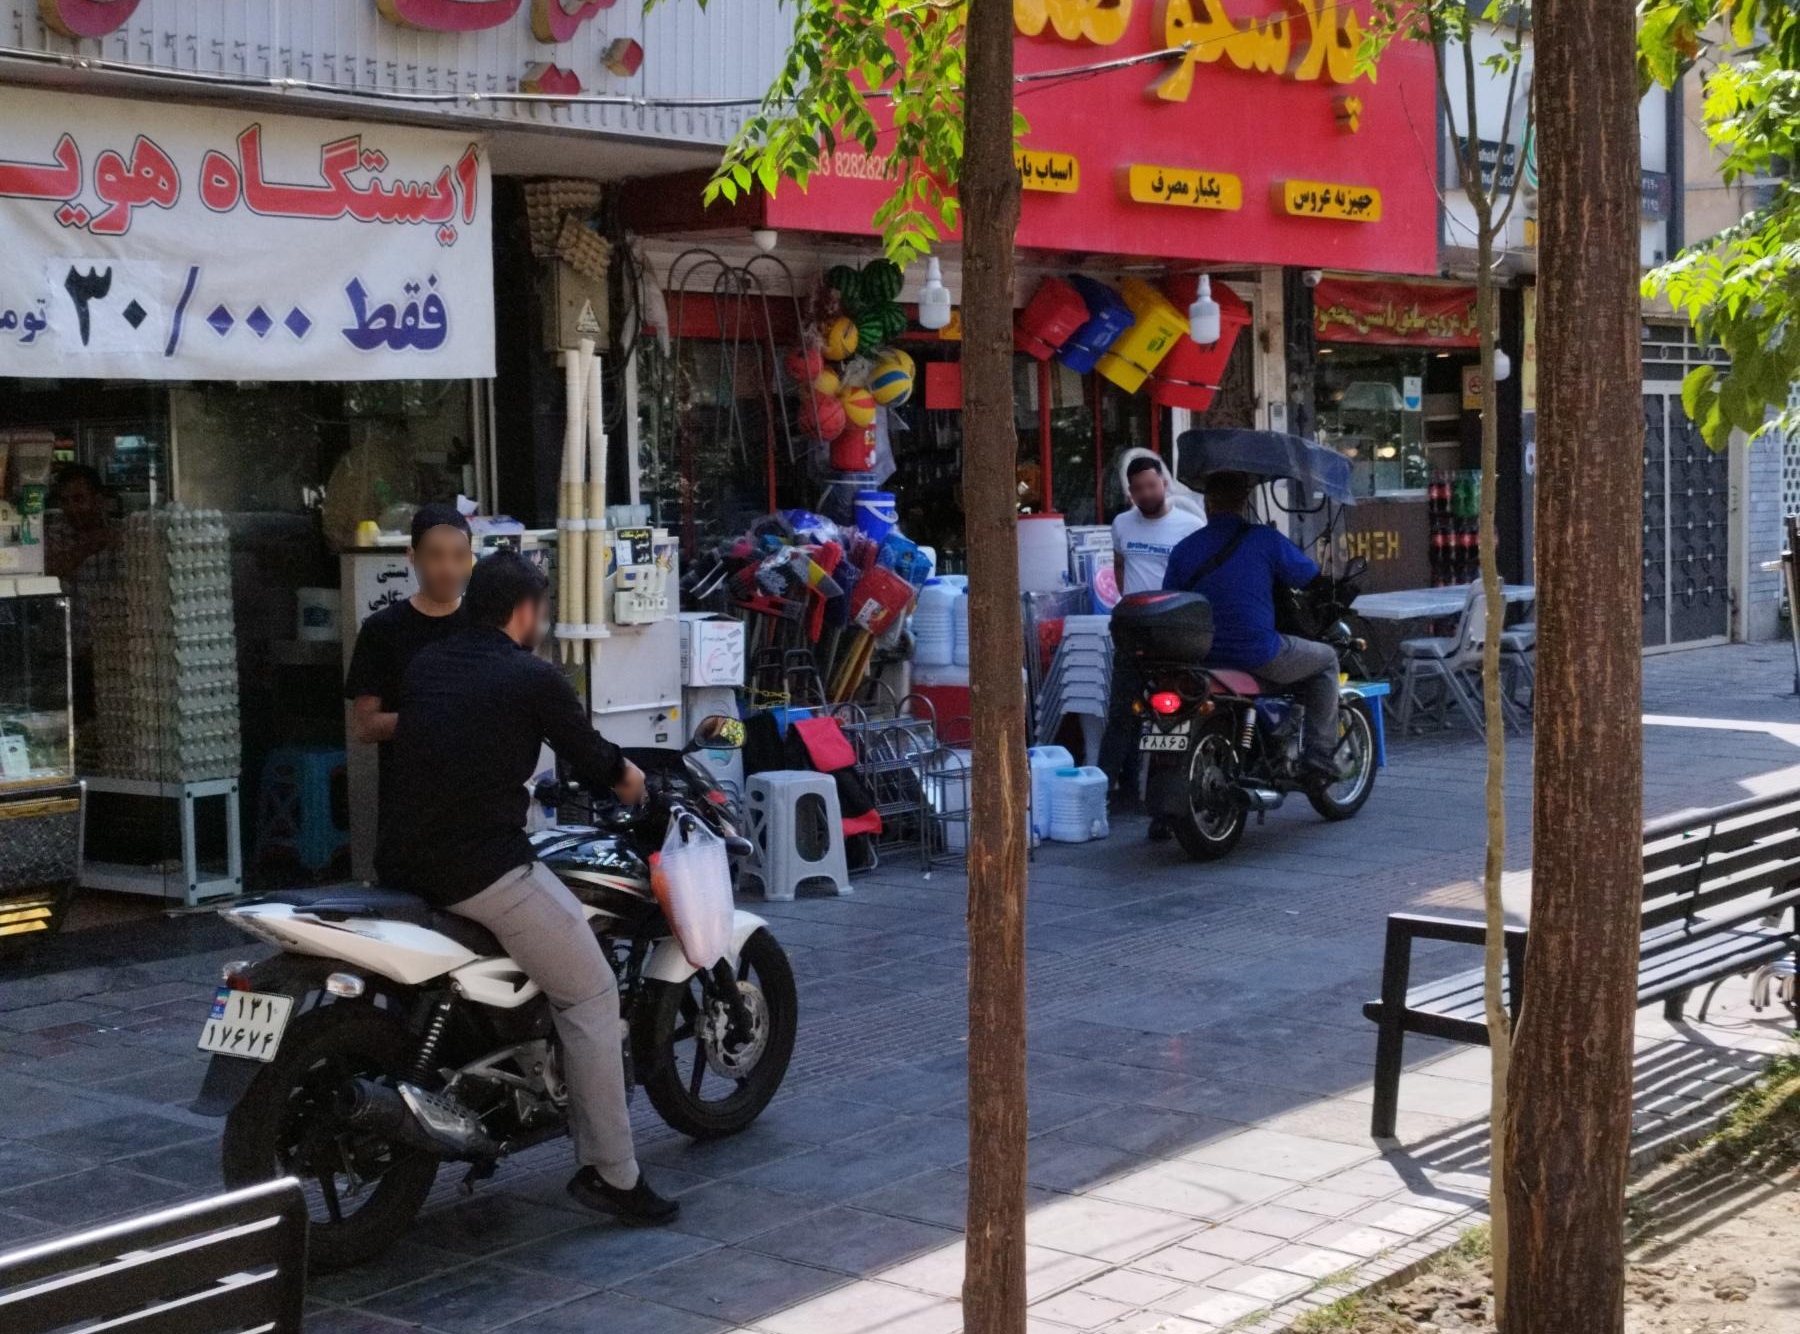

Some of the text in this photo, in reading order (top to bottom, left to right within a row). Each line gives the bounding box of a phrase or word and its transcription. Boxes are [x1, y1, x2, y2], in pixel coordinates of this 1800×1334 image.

[0, 123, 481, 246] ایستگاه هوی
[1035, 157, 1073, 186] اسباب
[1151, 170, 1221, 205] یکبار مصرف
[1293, 188, 1374, 218] جهیزیه عروس
[0, 298, 47, 343] توم
[342, 272, 449, 352] فقط
[238, 995, 272, 1023] ۱۳۱
[208, 1024, 274, 1054] ۱۷۶۷۴
